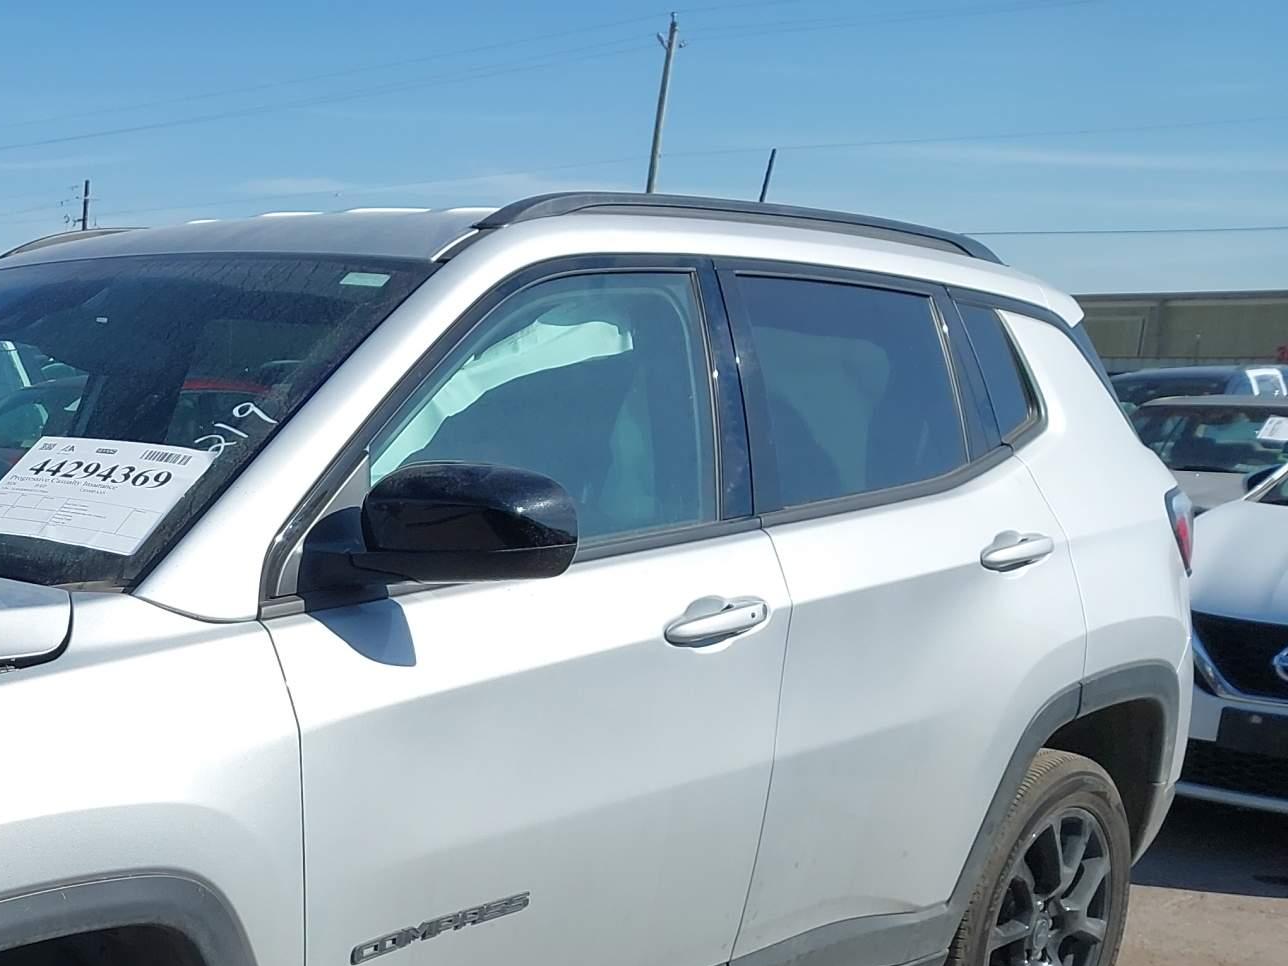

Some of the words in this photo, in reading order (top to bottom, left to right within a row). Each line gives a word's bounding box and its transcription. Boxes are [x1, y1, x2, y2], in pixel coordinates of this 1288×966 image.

[9, 474, 50, 483] Progressive
[82, 481, 118, 490] Insurance
[29, 458, 172, 489] 44294369
[349, 890, 531, 966] COMPASS
